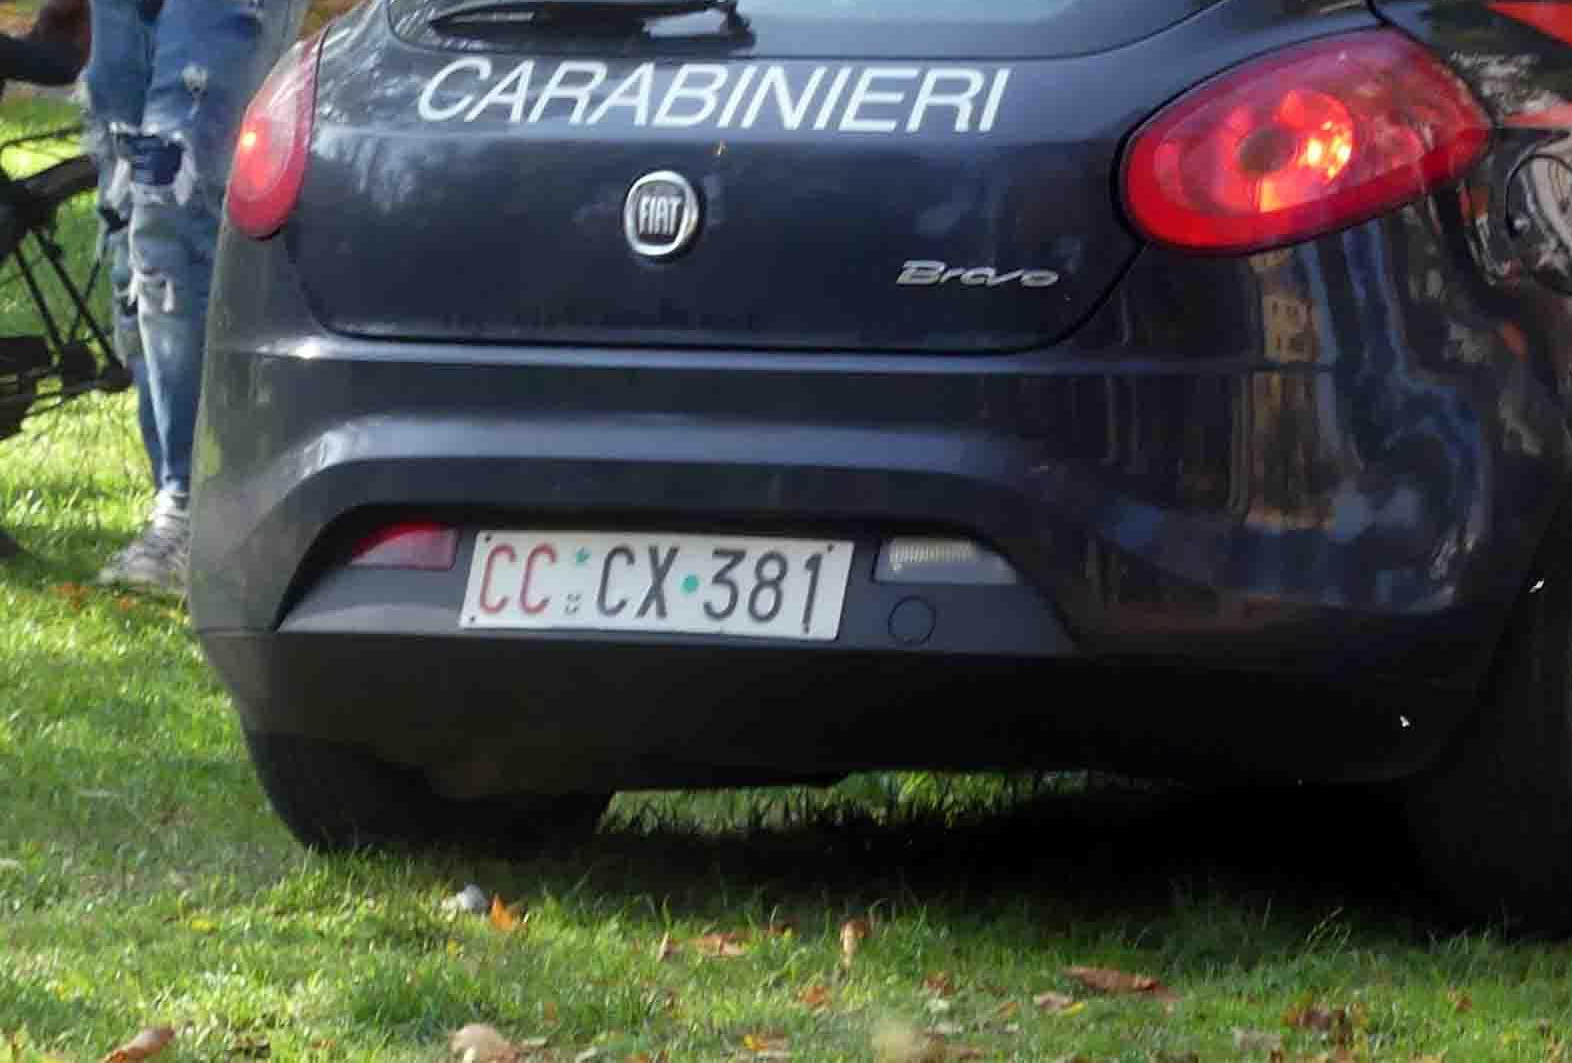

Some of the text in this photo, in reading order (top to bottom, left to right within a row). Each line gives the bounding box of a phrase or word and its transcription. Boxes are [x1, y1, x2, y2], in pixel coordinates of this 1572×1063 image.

[417, 56, 1010, 134] CARABINIERI
[639, 194, 683, 235] FIAT
[896, 260, 1059, 288] Bravo
[703, 547, 823, 634] 381
